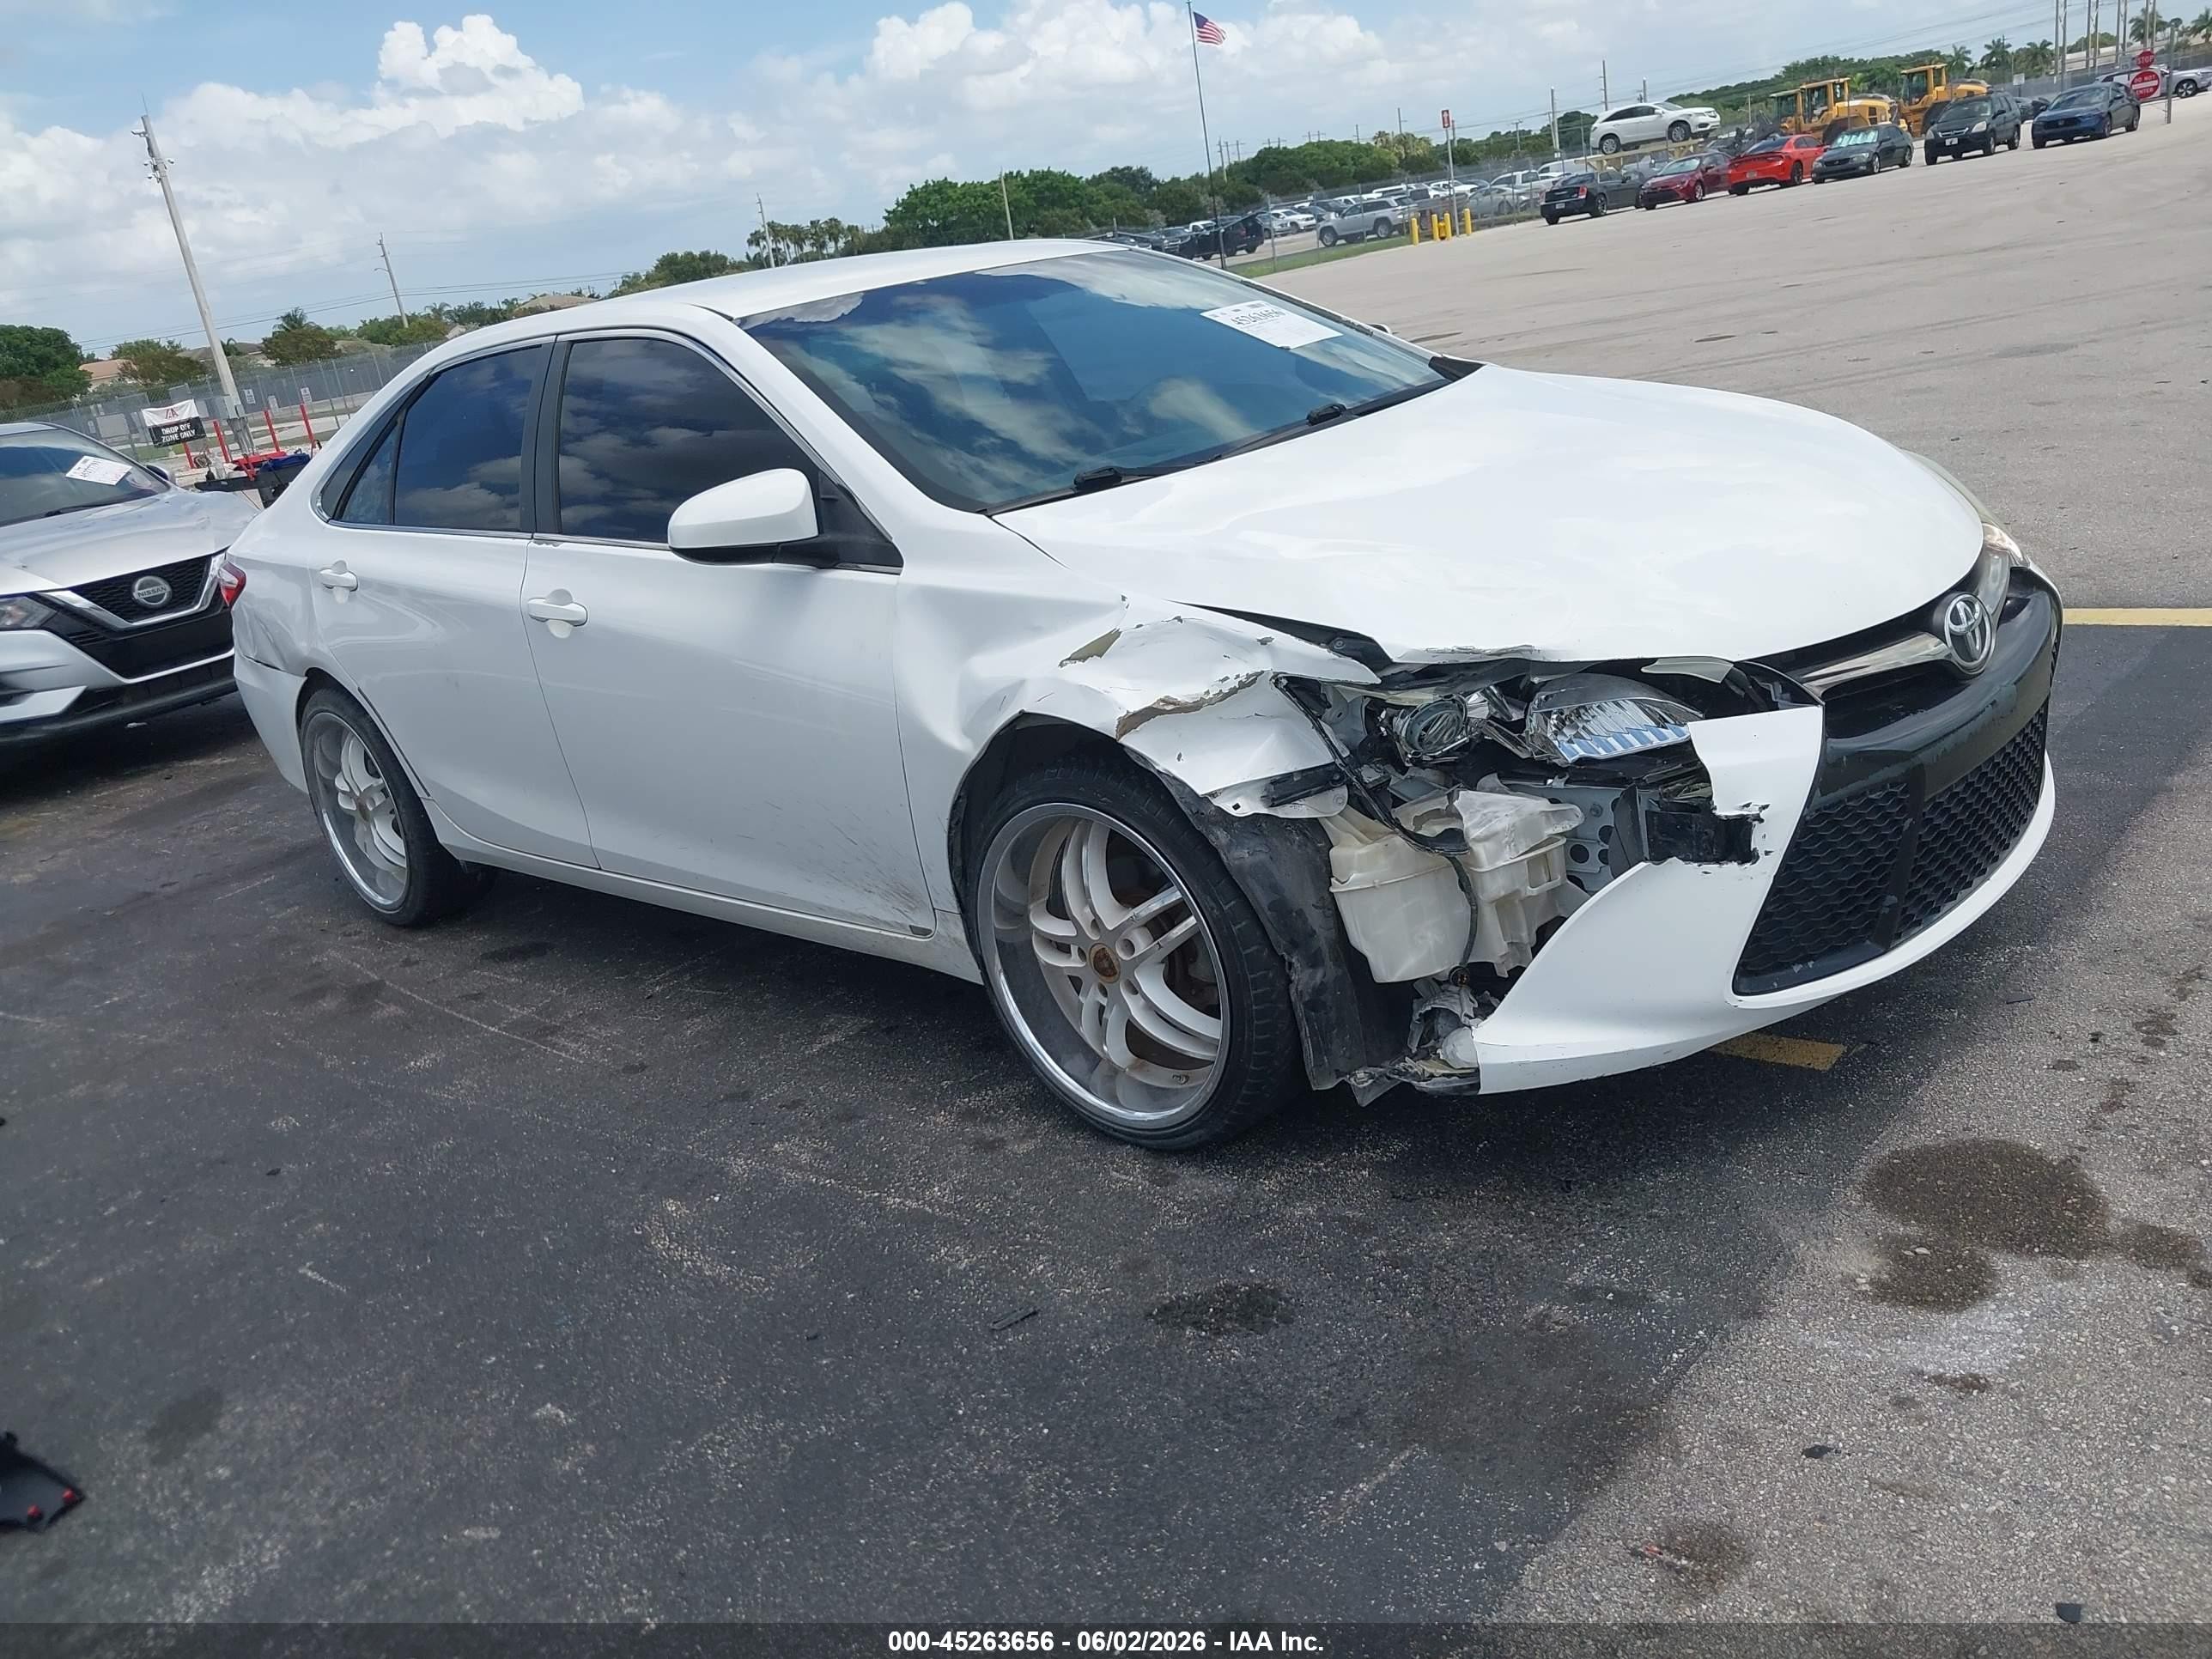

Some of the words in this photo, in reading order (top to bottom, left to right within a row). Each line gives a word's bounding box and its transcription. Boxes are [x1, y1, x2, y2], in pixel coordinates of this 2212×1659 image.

[2136, 55, 2154, 64] STOP
[161, 426, 179, 434] DROP
[161, 434, 179, 442] ZONE
[180, 428, 196, 439] ONLY
[137, 586, 167, 598] NISSAN
